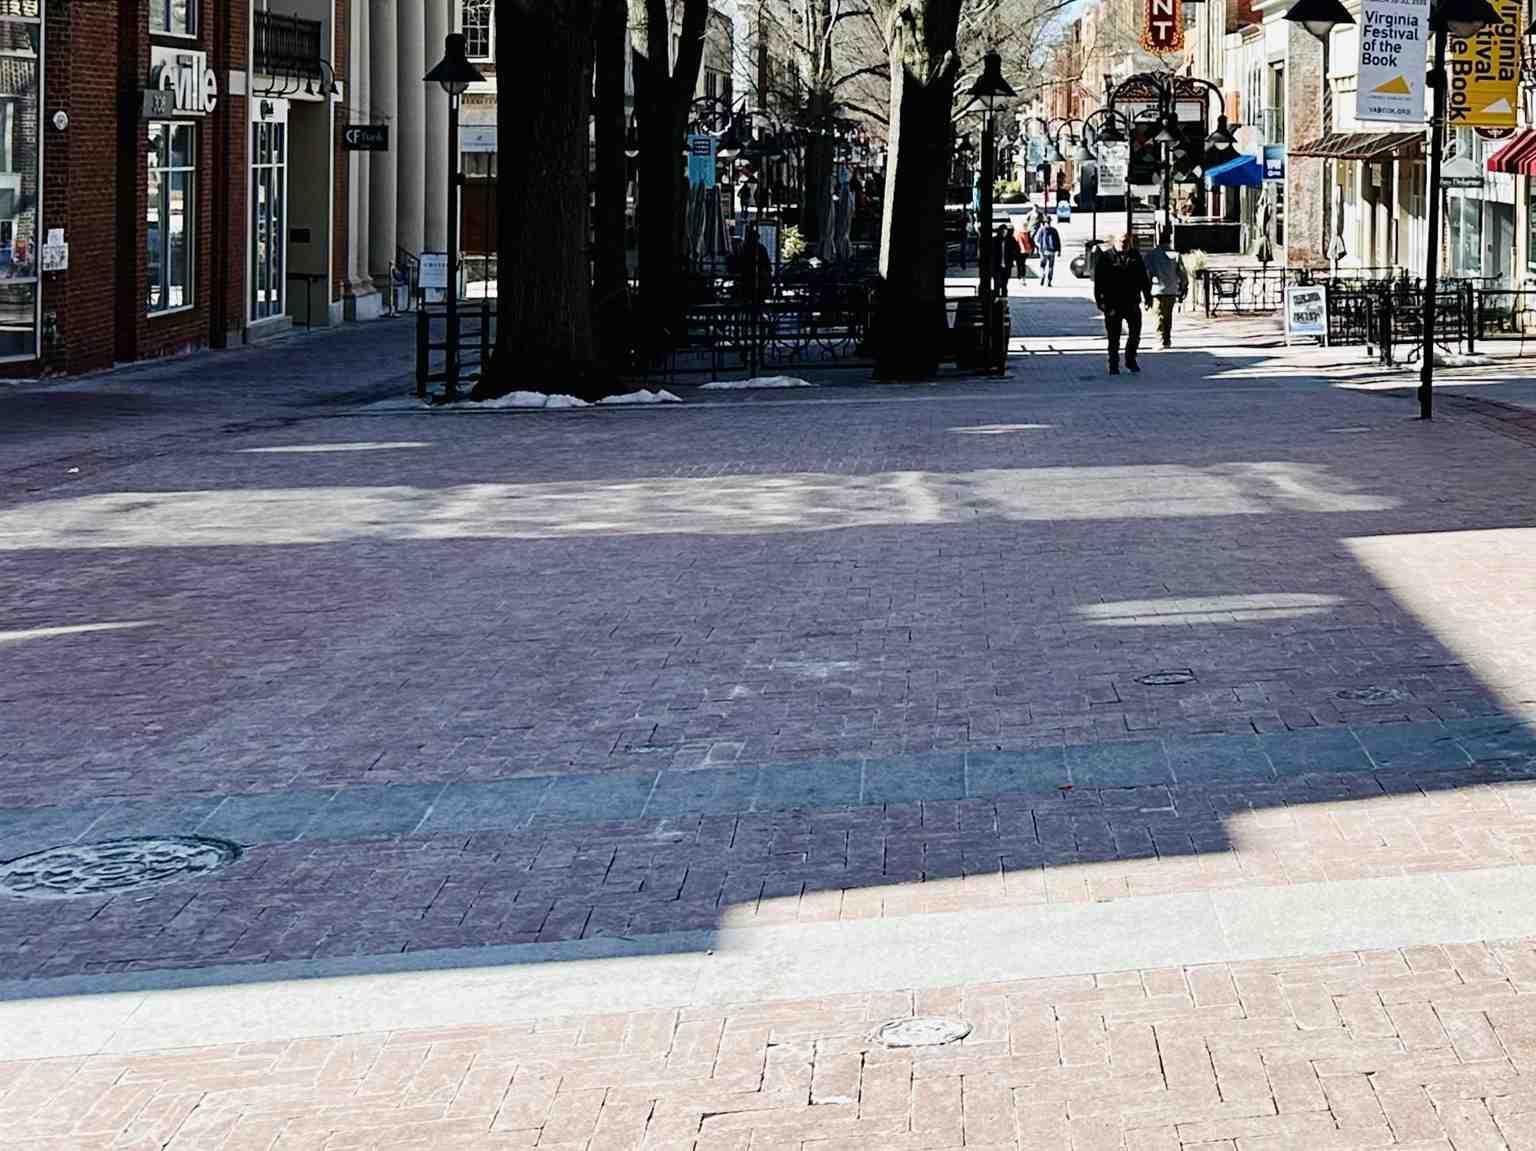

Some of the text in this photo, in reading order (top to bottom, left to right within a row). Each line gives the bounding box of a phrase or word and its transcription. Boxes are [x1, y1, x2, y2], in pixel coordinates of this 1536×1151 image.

[1364, 9, 1419, 28] Virginia
[1363, 24, 1419, 41] Festival
[1362, 39, 1402, 54] of the
[1362, 52, 1398, 68] Book
[1450, 60, 1473, 121] Book
